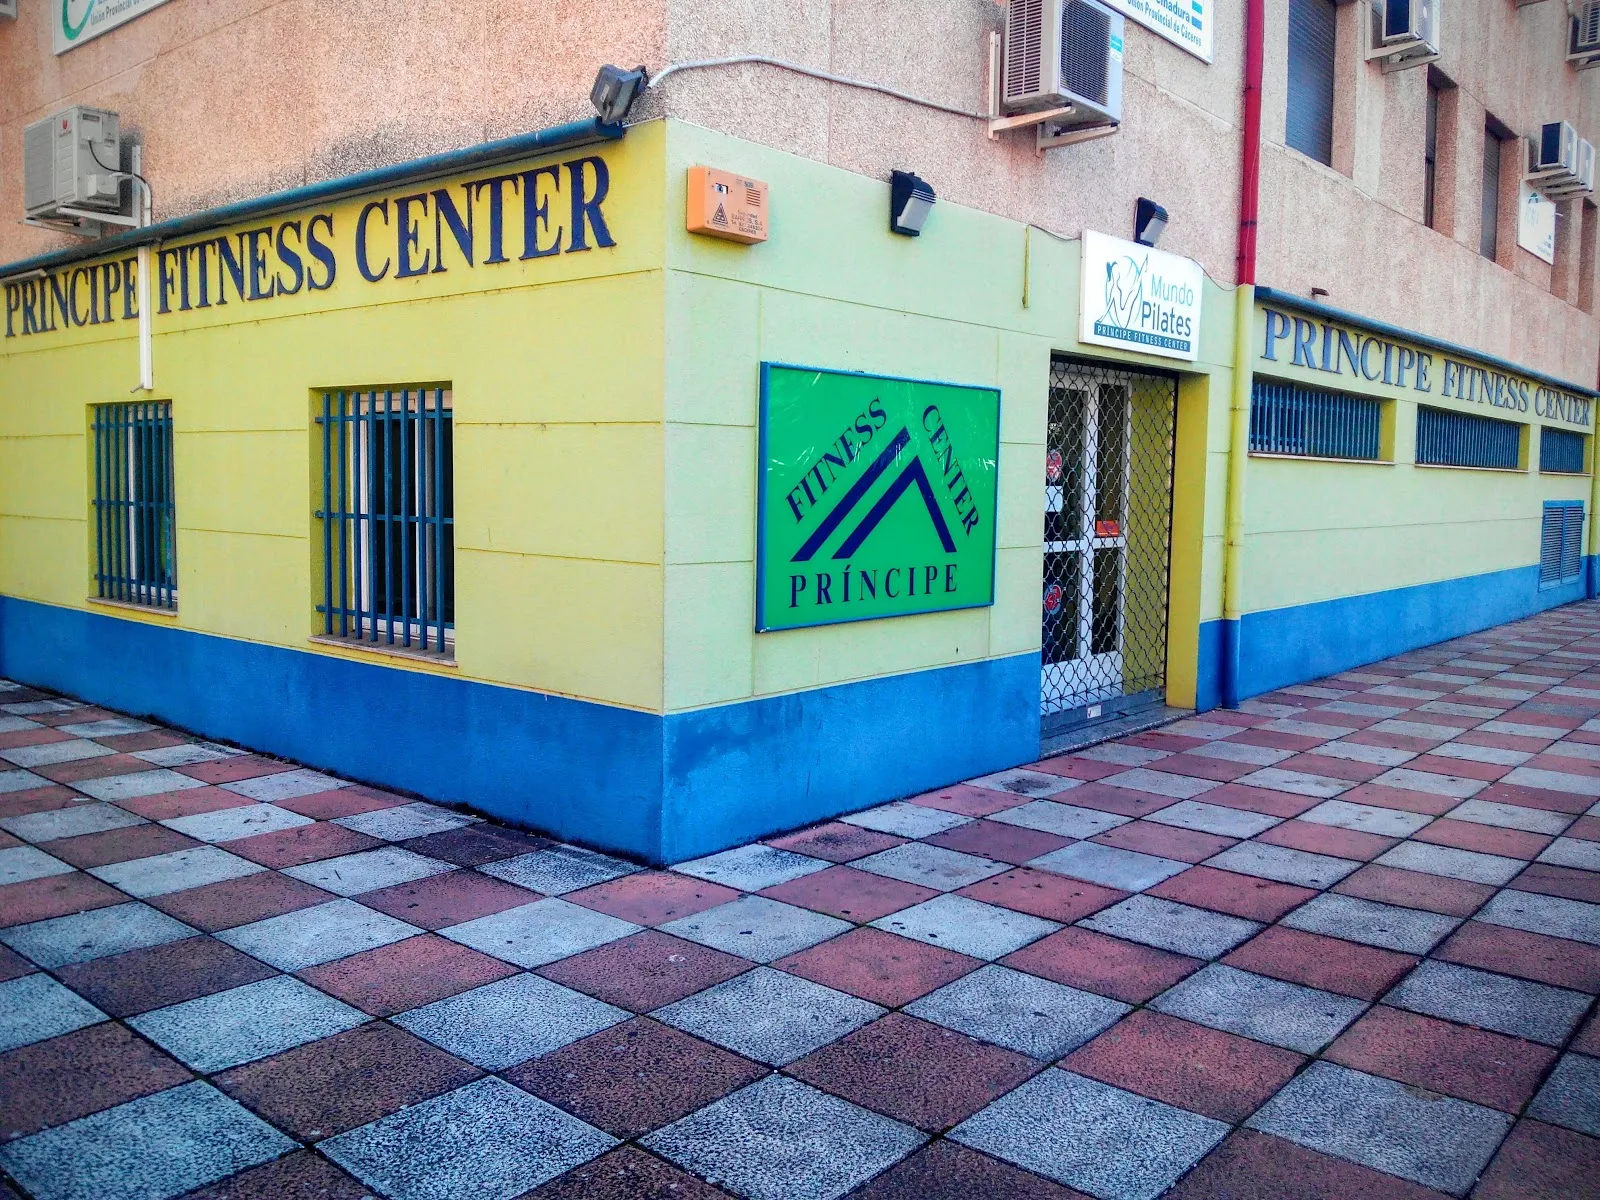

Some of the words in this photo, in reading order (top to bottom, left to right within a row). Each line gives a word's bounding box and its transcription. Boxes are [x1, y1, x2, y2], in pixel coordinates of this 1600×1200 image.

[1144, 1, 1173, 29] Provincial
[1173, 20, 1180, 34] de
[156, 212, 337, 314] FITNESS
[355, 155, 617, 282] CENTER
[1151, 272, 1194, 307] Mundo
[1141, 300, 1192, 337] Pilates
[1134, 331, 1162, 346] FITNESS
[1163, 338, 1188, 351] CENTER
[1260, 307, 1433, 392] PRINCIPE
[1441, 358, 1530, 413] FITNESS
[1534, 384, 1590, 427] CENTER
[784, 396, 887, 525] FITNESS
[922, 404, 979, 537] CENTER
[788, 563, 958, 608] PRÍNCIPE
